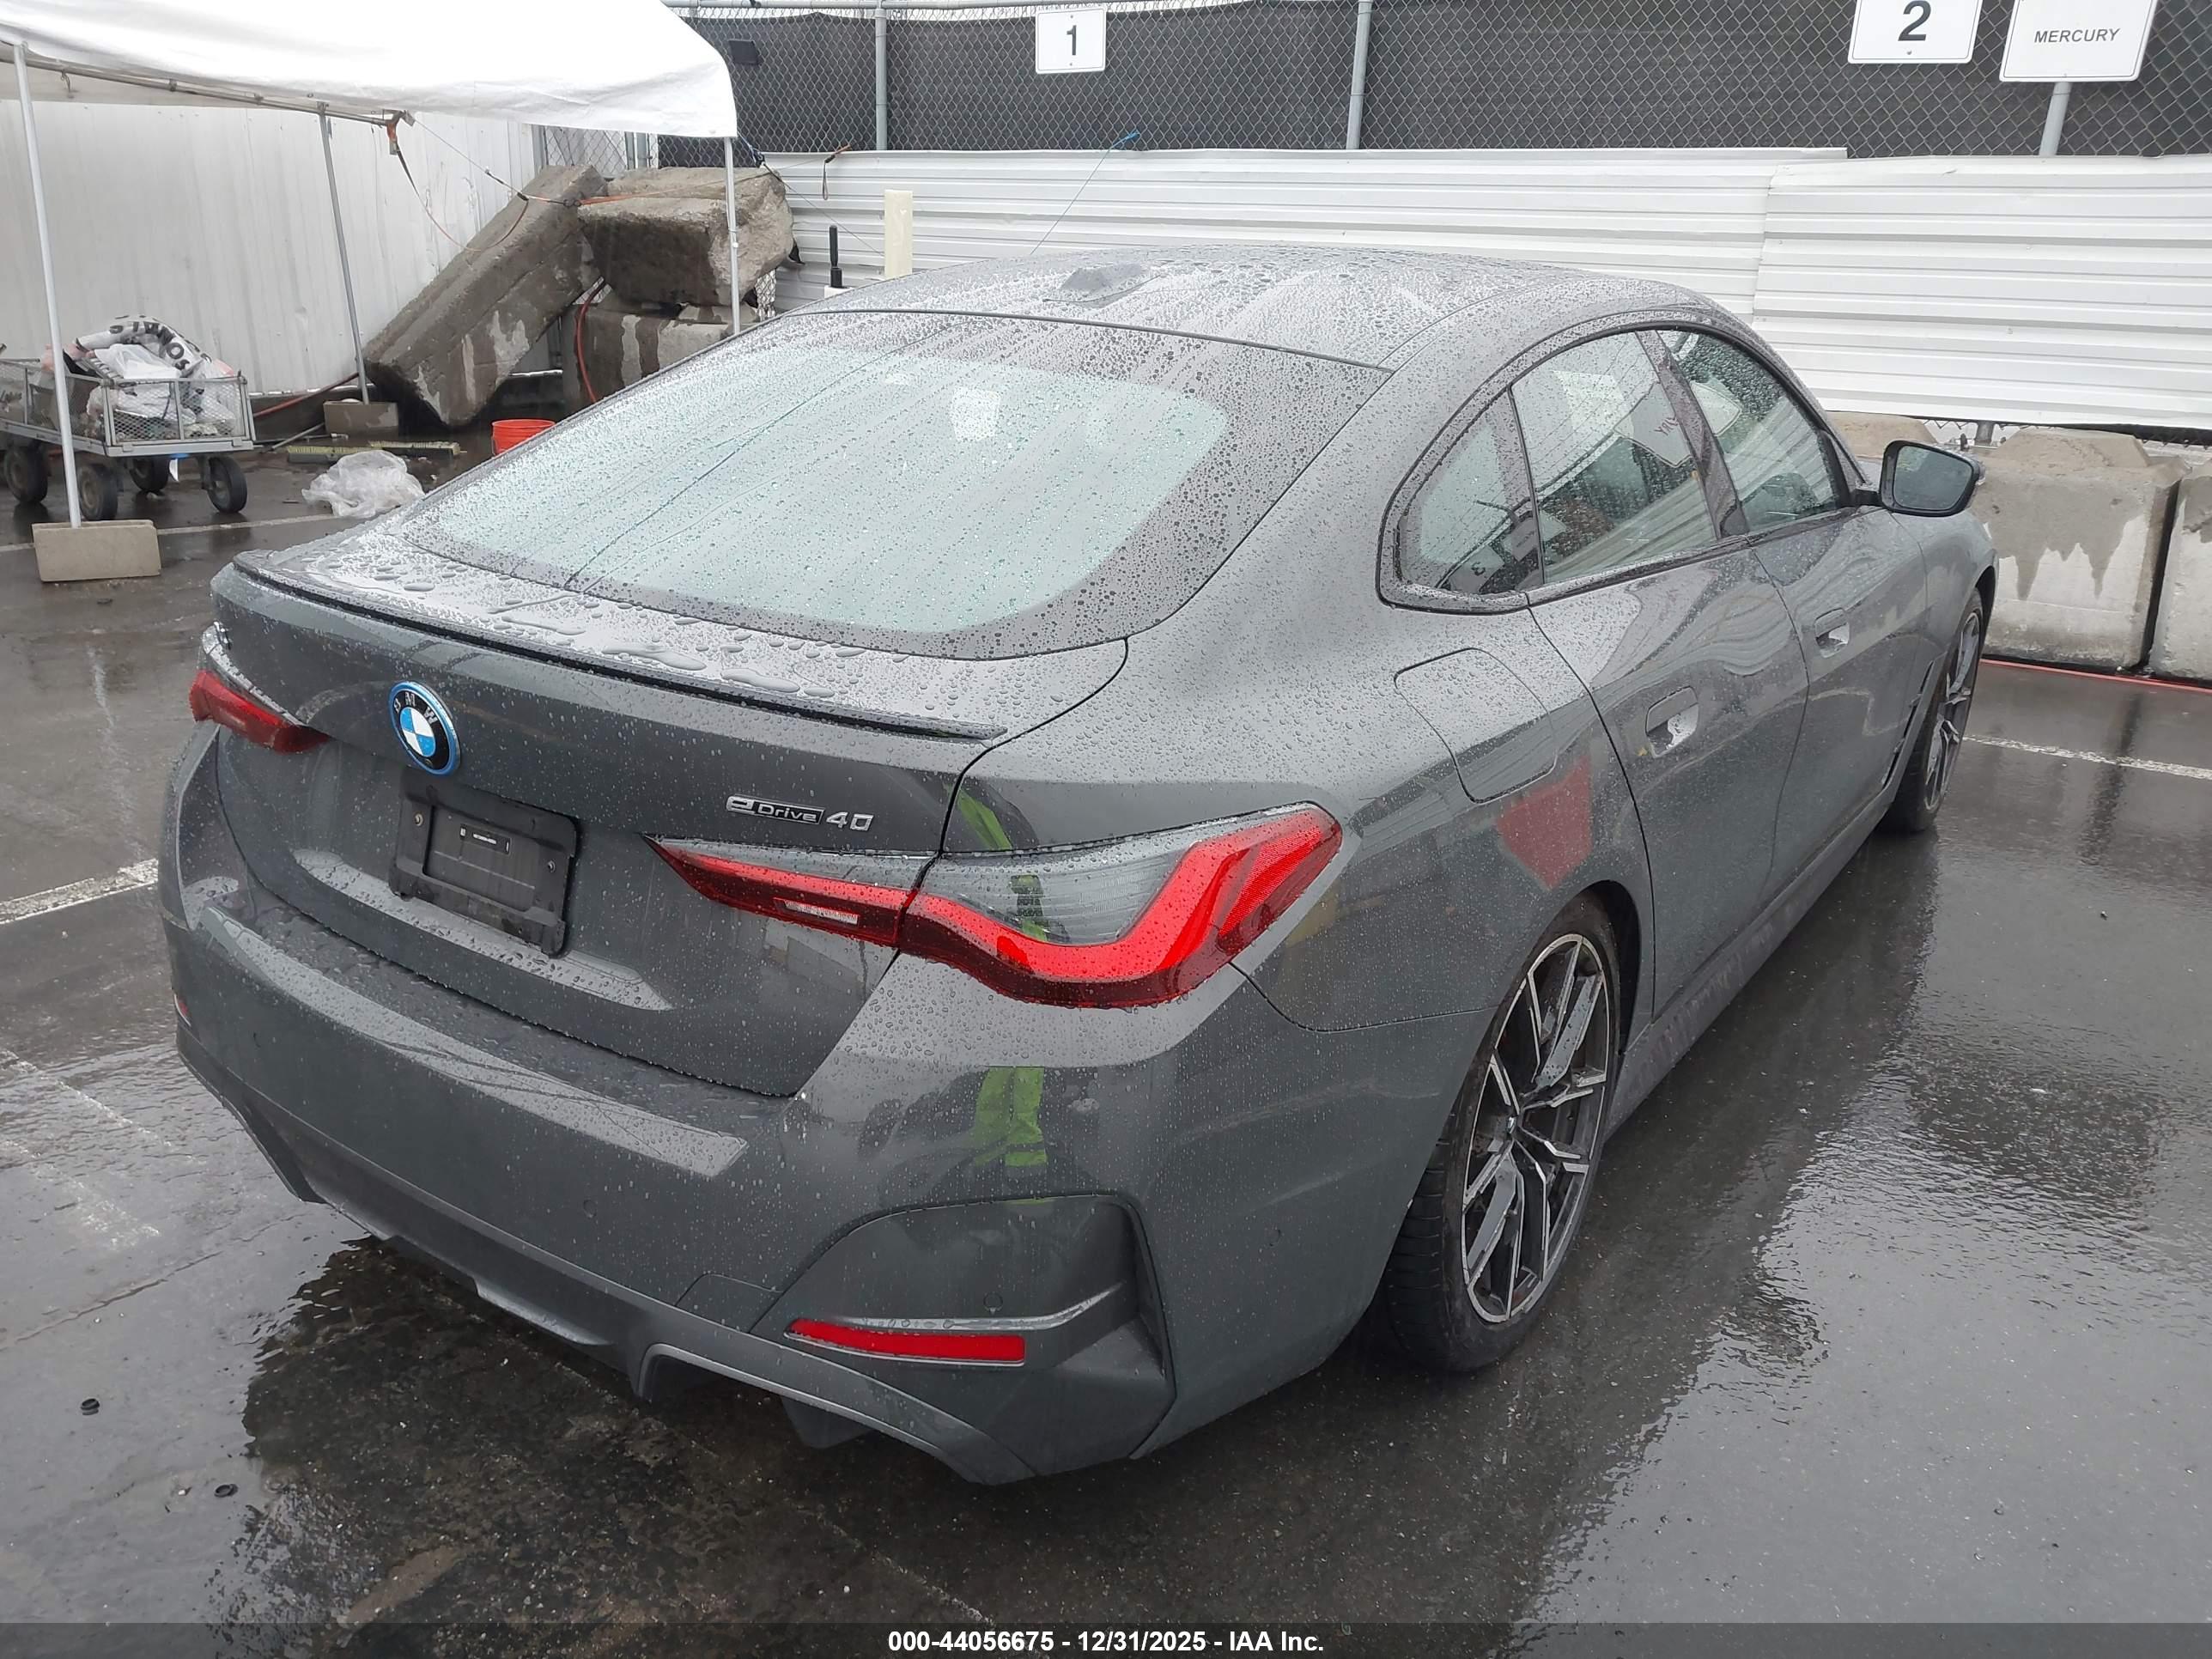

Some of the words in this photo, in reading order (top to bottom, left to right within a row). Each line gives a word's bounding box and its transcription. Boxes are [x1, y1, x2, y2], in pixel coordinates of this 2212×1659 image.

[1898, 0, 1932, 41] 2
[2033, 28, 2121, 43] MERCURY
[1066, 25, 1077, 56] 1
[393, 691, 439, 725] BMW
[826, 811, 874, 831] 40
